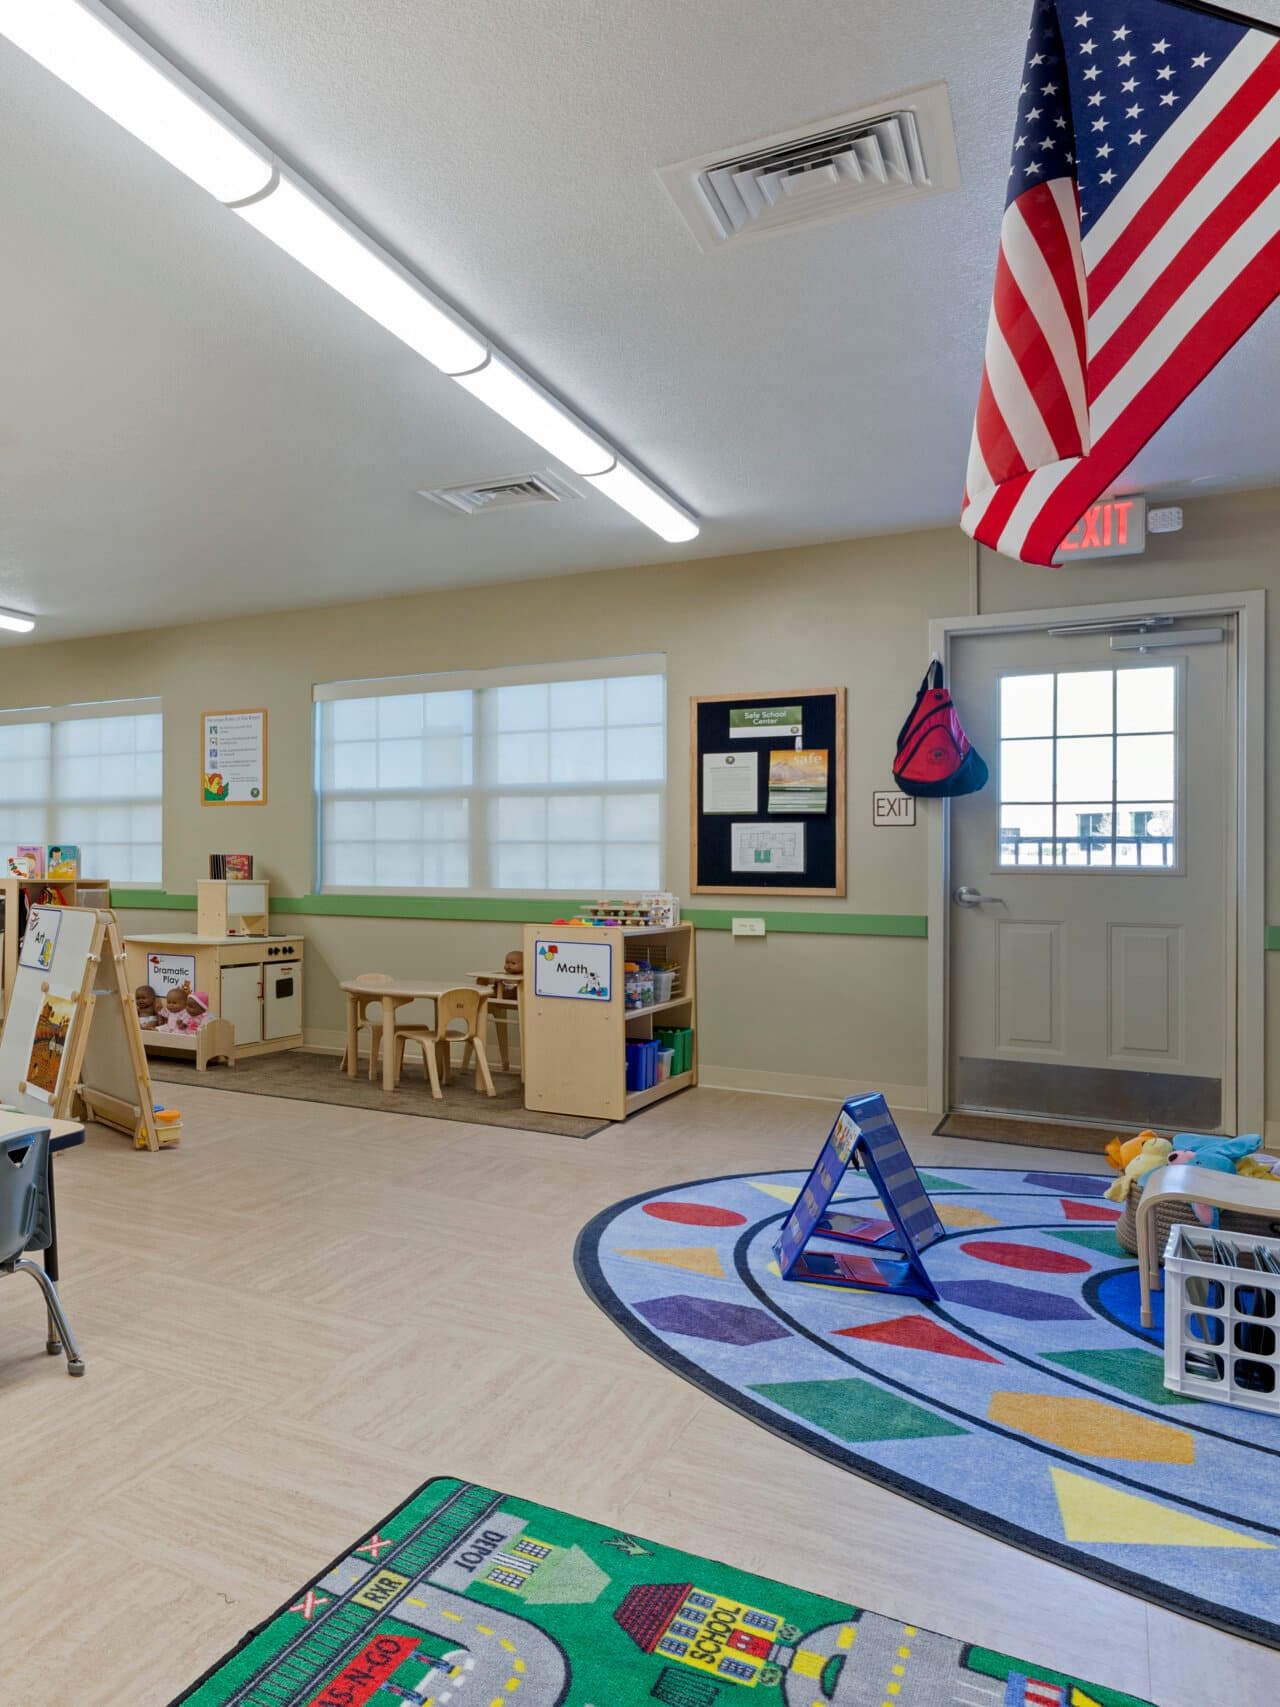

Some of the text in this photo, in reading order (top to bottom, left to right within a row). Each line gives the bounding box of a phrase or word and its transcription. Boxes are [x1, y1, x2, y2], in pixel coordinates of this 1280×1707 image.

[743, 709, 788, 720] Safe School
[752, 718, 779, 726] Center
[876, 797, 913, 818] EXIT
[153, 965, 190, 976] Dramatic
[556, 962, 588, 976] Math
[162, 975, 180, 986] Play
[453, 1529, 508, 1574] DEPOT
[362, 1576, 403, 1605] RXR
[688, 1605, 742, 1666] SCHOOL
